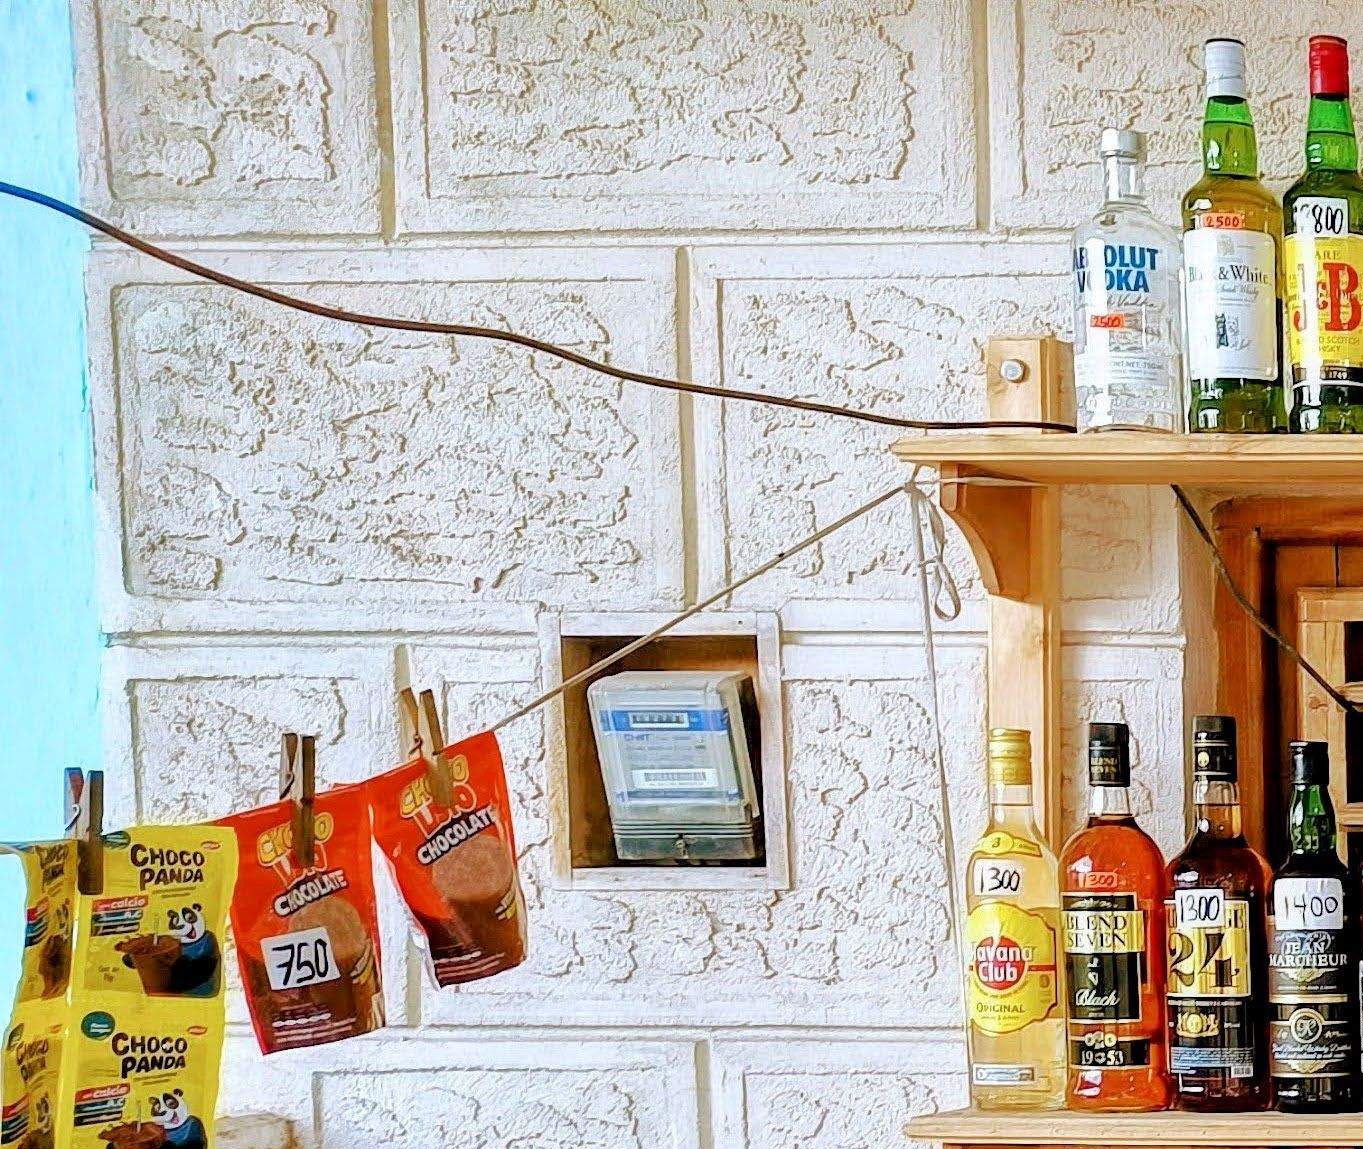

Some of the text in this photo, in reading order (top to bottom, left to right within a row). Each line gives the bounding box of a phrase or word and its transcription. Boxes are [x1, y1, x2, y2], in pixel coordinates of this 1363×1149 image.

[1205, 215, 1240, 227] 2500
[130, 843, 205, 868] CHOCO
[139, 865, 204, 890] PANDA
[979, 867, 1021, 893] 1300
[1181, 895, 1220, 922] 1300
[1285, 895, 1339, 919] 1400
[1067, 915, 1127, 930] BLEND
[1067, 932, 1127, 947] SEVEN
[271, 938, 329, 985] 750
[976, 1002, 1026, 1014] ORIGINAL
[121, 1054, 186, 1079] PANDA
